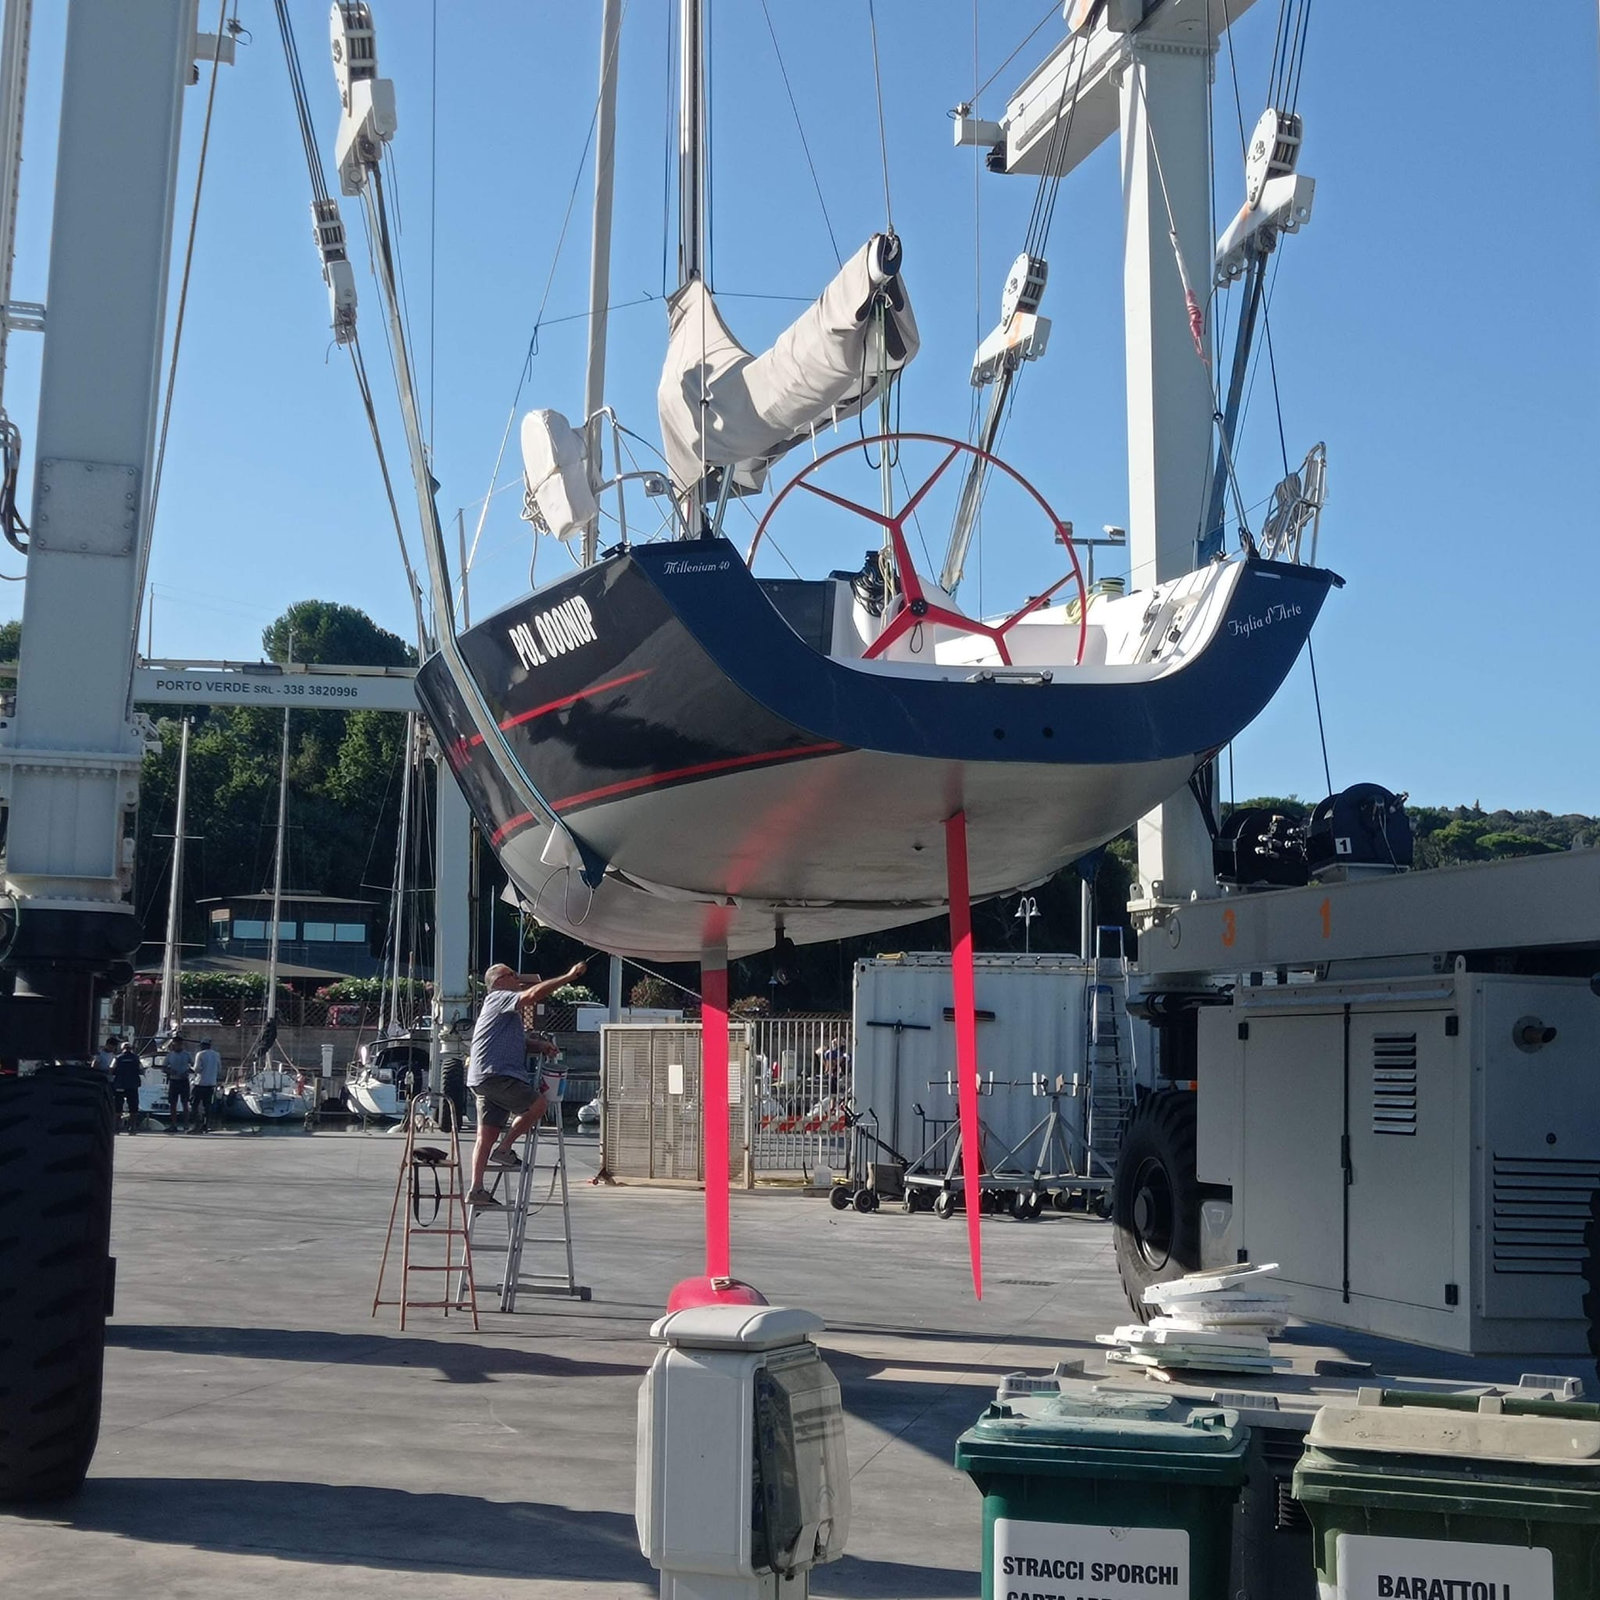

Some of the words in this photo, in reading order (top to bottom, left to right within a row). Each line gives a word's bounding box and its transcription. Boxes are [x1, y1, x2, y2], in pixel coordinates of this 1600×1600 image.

[663, 561, 716, 575] Millenium
[719, 560, 730, 570] 40
[1227, 614, 1263, 638] Figlia
[508, 623, 547, 671] POL
[156, 680, 202, 691] PORTO
[206, 682, 250, 693] VERDE
[254, 685, 274, 694] SRL
[284, 684, 304, 695] 338
[309, 685, 358, 697] 3820996
[1338, 839, 1347, 852] 1
[1221, 909, 1236, 948] 3
[1319, 897, 1331, 939] 1
[1003, 1556, 1084, 1580] STRACCI
[1091, 1562, 1179, 1585] SPORCHI
